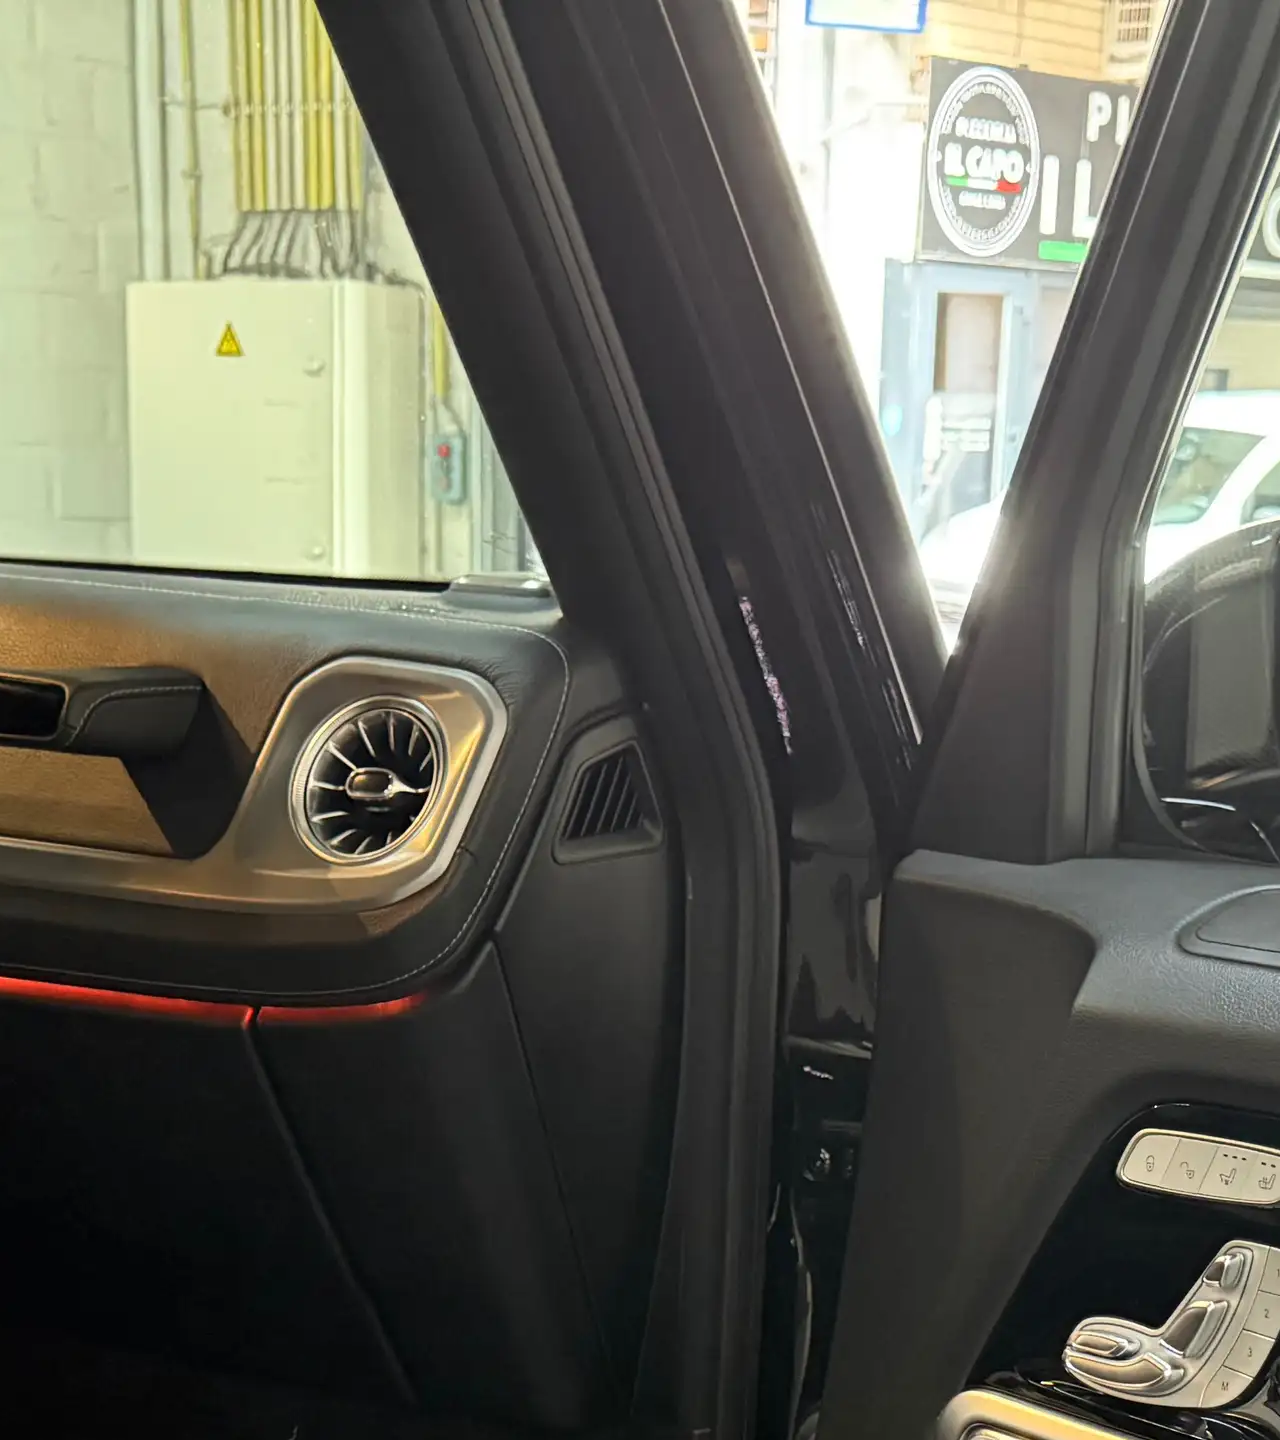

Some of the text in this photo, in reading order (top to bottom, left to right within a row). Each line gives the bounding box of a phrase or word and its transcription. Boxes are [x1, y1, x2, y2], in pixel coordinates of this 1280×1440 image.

[966, 145, 1024, 183] CAPO
[1264, 1308, 1270, 1319] 2
[1247, 1347, 1253, 1358] 3
[1221, 1381, 1229, 1392] M
